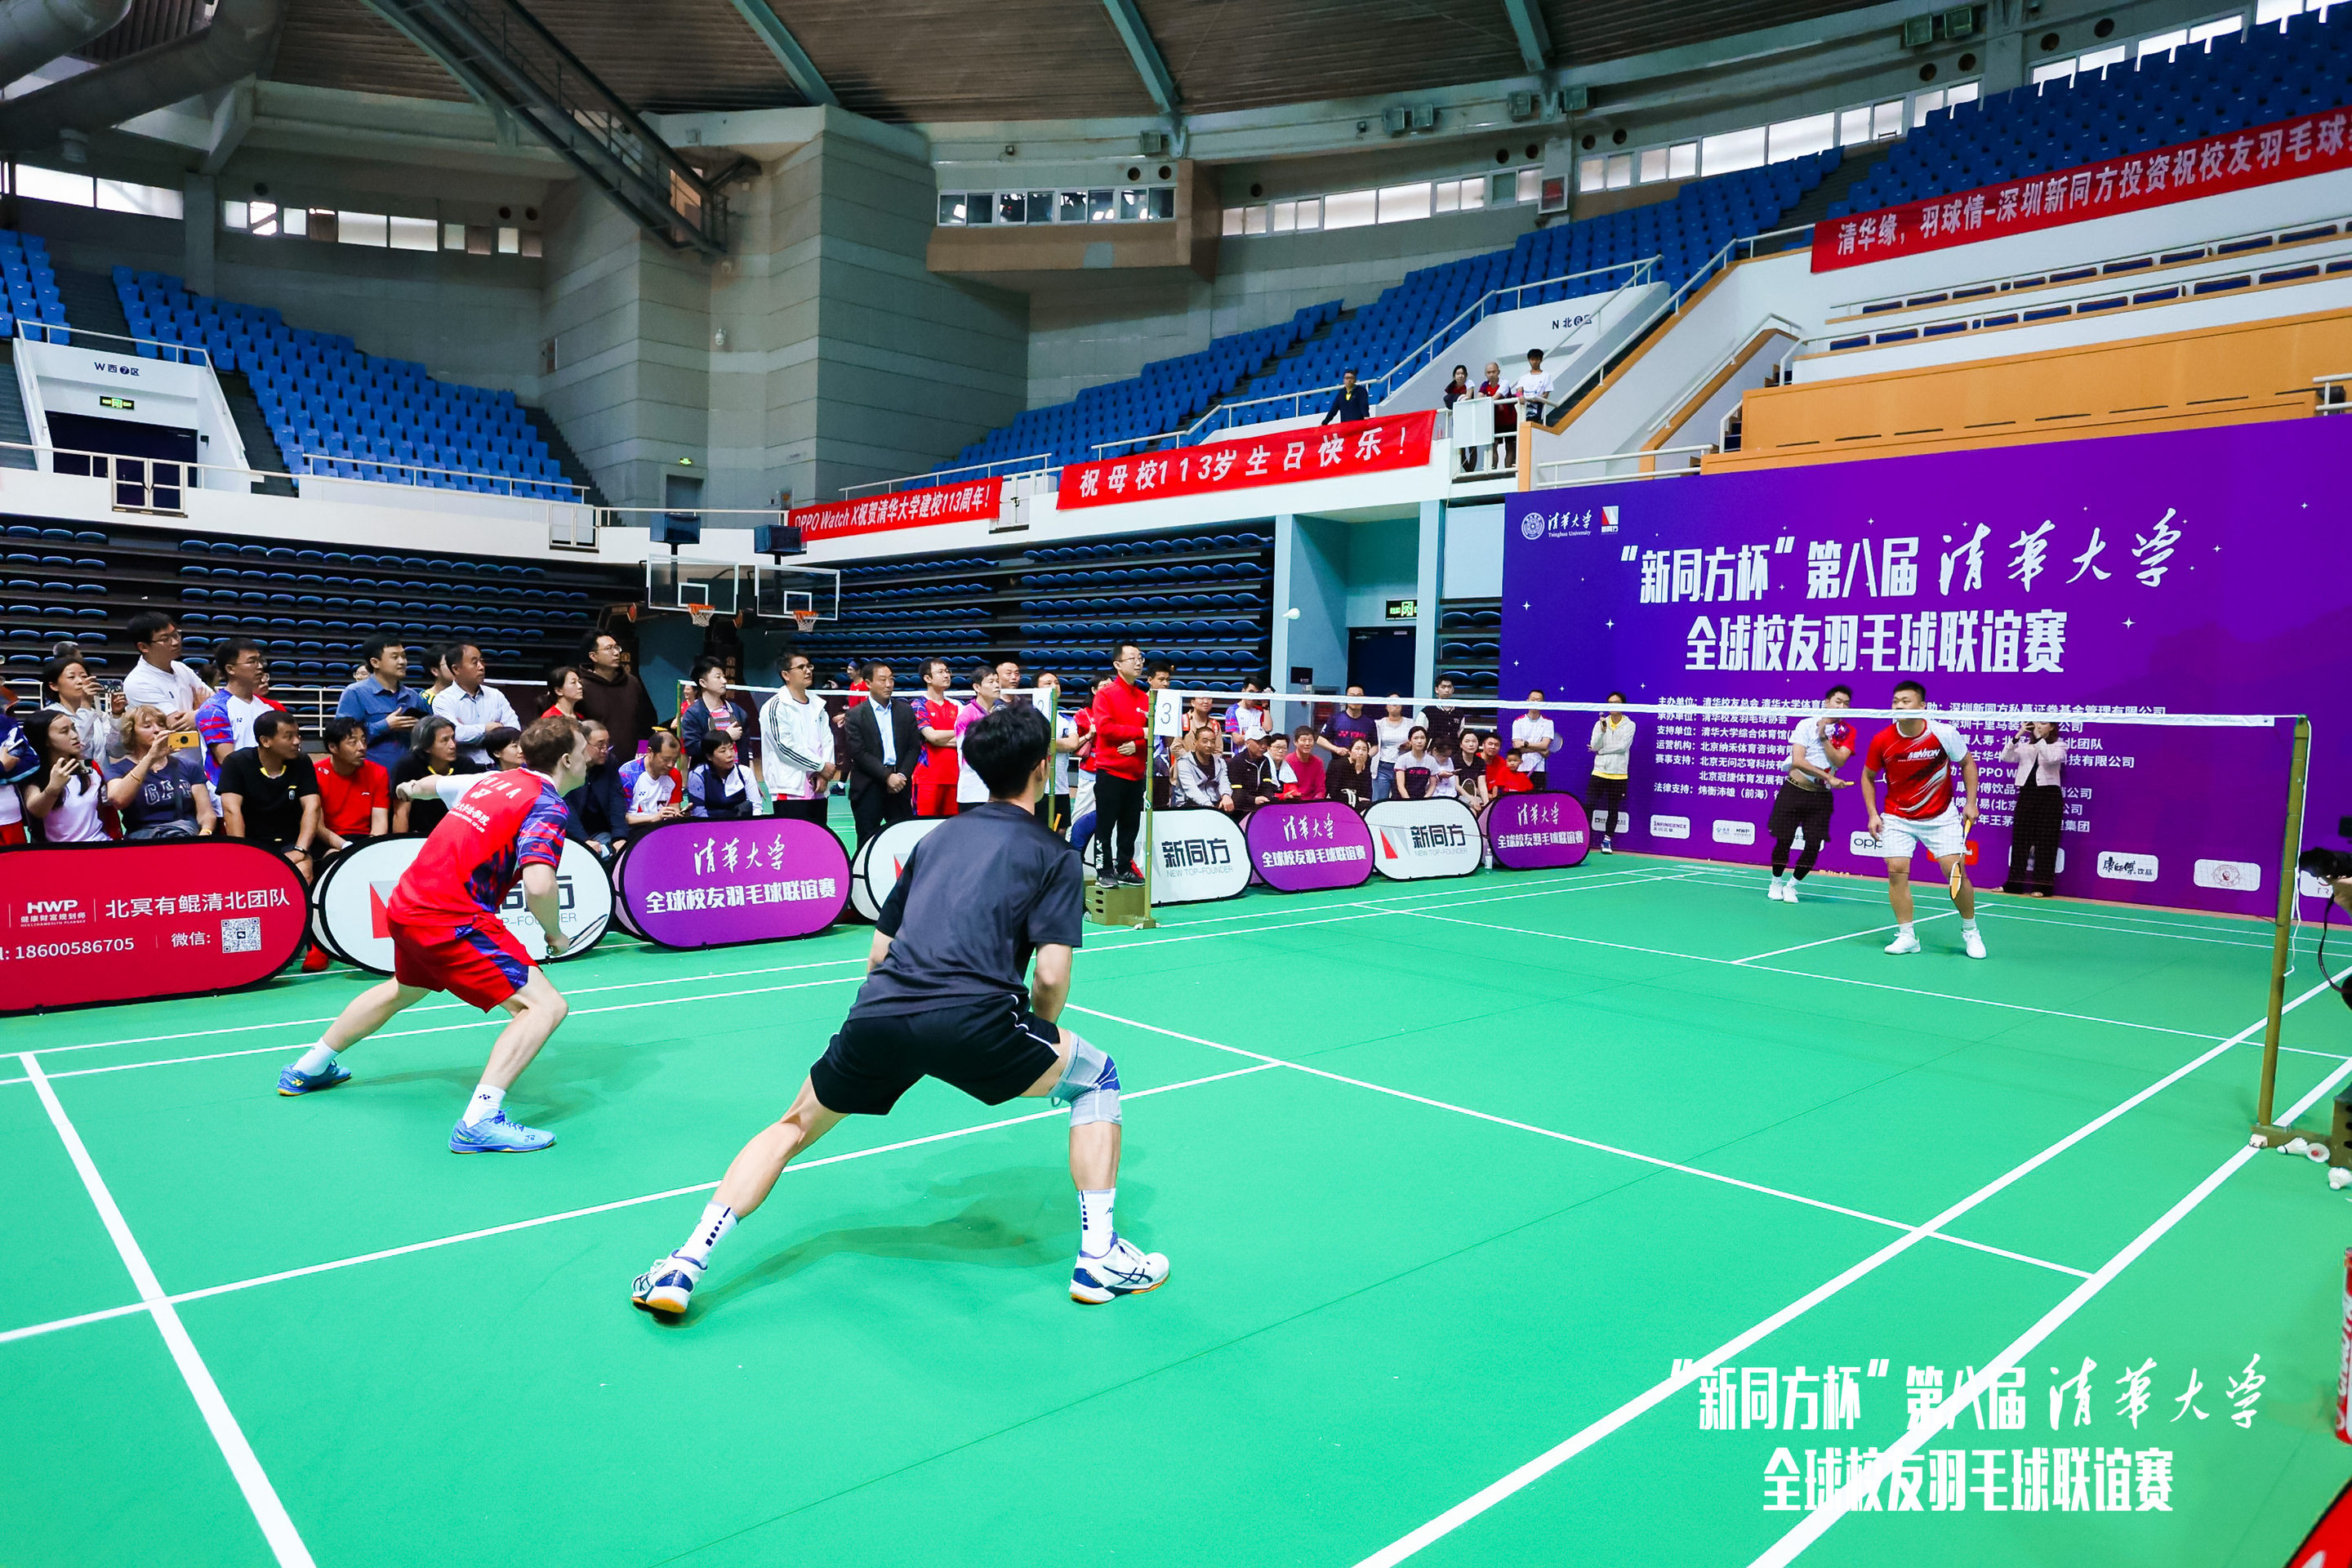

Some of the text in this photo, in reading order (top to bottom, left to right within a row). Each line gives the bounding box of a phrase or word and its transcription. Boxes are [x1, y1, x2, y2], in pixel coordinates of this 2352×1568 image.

[795, 514, 819, 532] OPPO
[820, 508, 848, 529] Watch
[1686, 608, 2067, 673] 全球校友羽毛球联谊赛
[1160, 702, 1172, 724] 3
[1699, 771, 1788, 786] 北京冠捷体育发展有
[145, 779, 192, 805] GAP
[1410, 824, 1466, 849] 新同方
[1498, 831, 1584, 849] 全球校友羽毛球联谊赛
[1161, 838, 1231, 868] 新同方
[1262, 845, 1367, 868] 全球校友羽毛球联谊赛
[1166, 866, 1234, 878] NEW TOP-FOUNDER
[27, 887, 291, 919] HWP 北冥有鲲清北团队
[645, 878, 836, 914] 全球校友羽毛球联谊赛
[20, 911, 86, 924] 健康财富规划师
[15, 938, 135, 960] 18600586705
